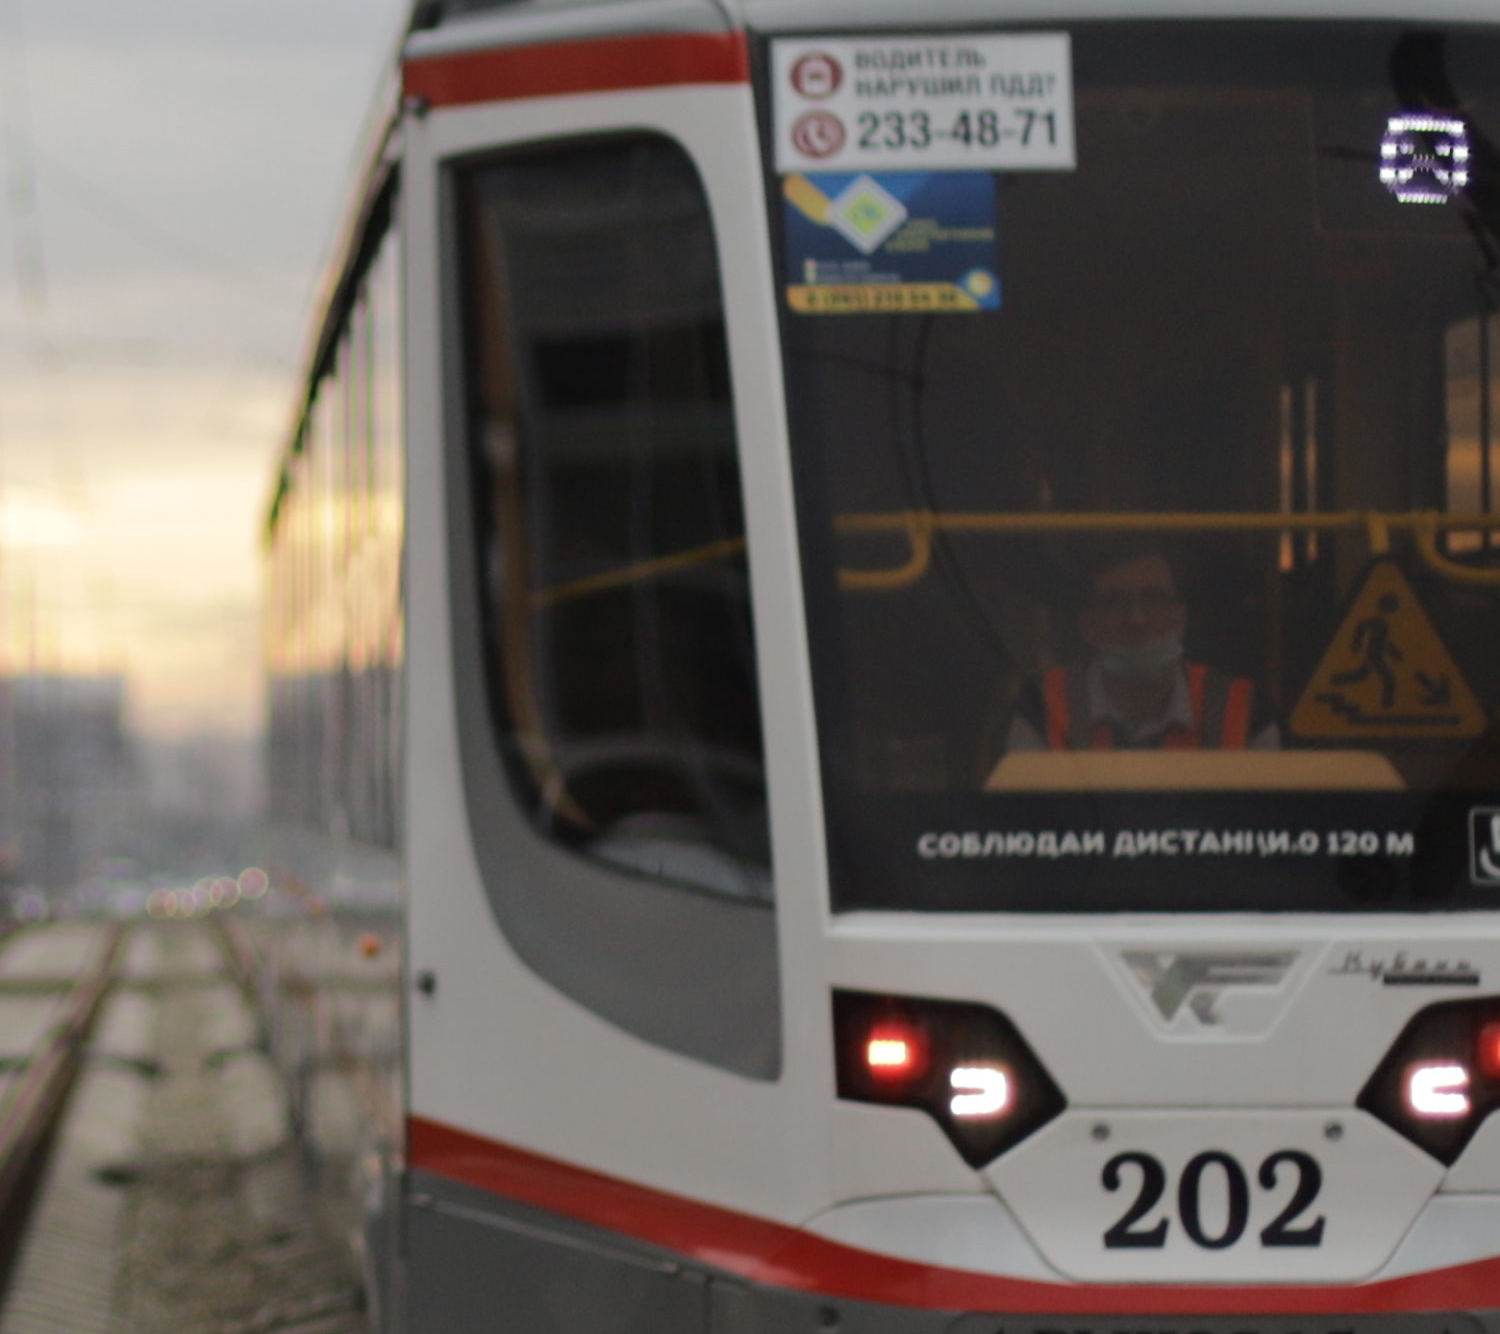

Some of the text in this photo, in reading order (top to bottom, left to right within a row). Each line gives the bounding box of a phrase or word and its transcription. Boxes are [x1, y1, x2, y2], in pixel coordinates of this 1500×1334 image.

[854, 48, 986, 69] ВОДИТЕЛЬ
[855, 73, 1057, 97] НАРУШИЛ ПДД?
[857, 109, 1057, 149] 233-48-71
[1327, 829, 1379, 855] 120
[1101, 1149, 1327, 1251] 202
